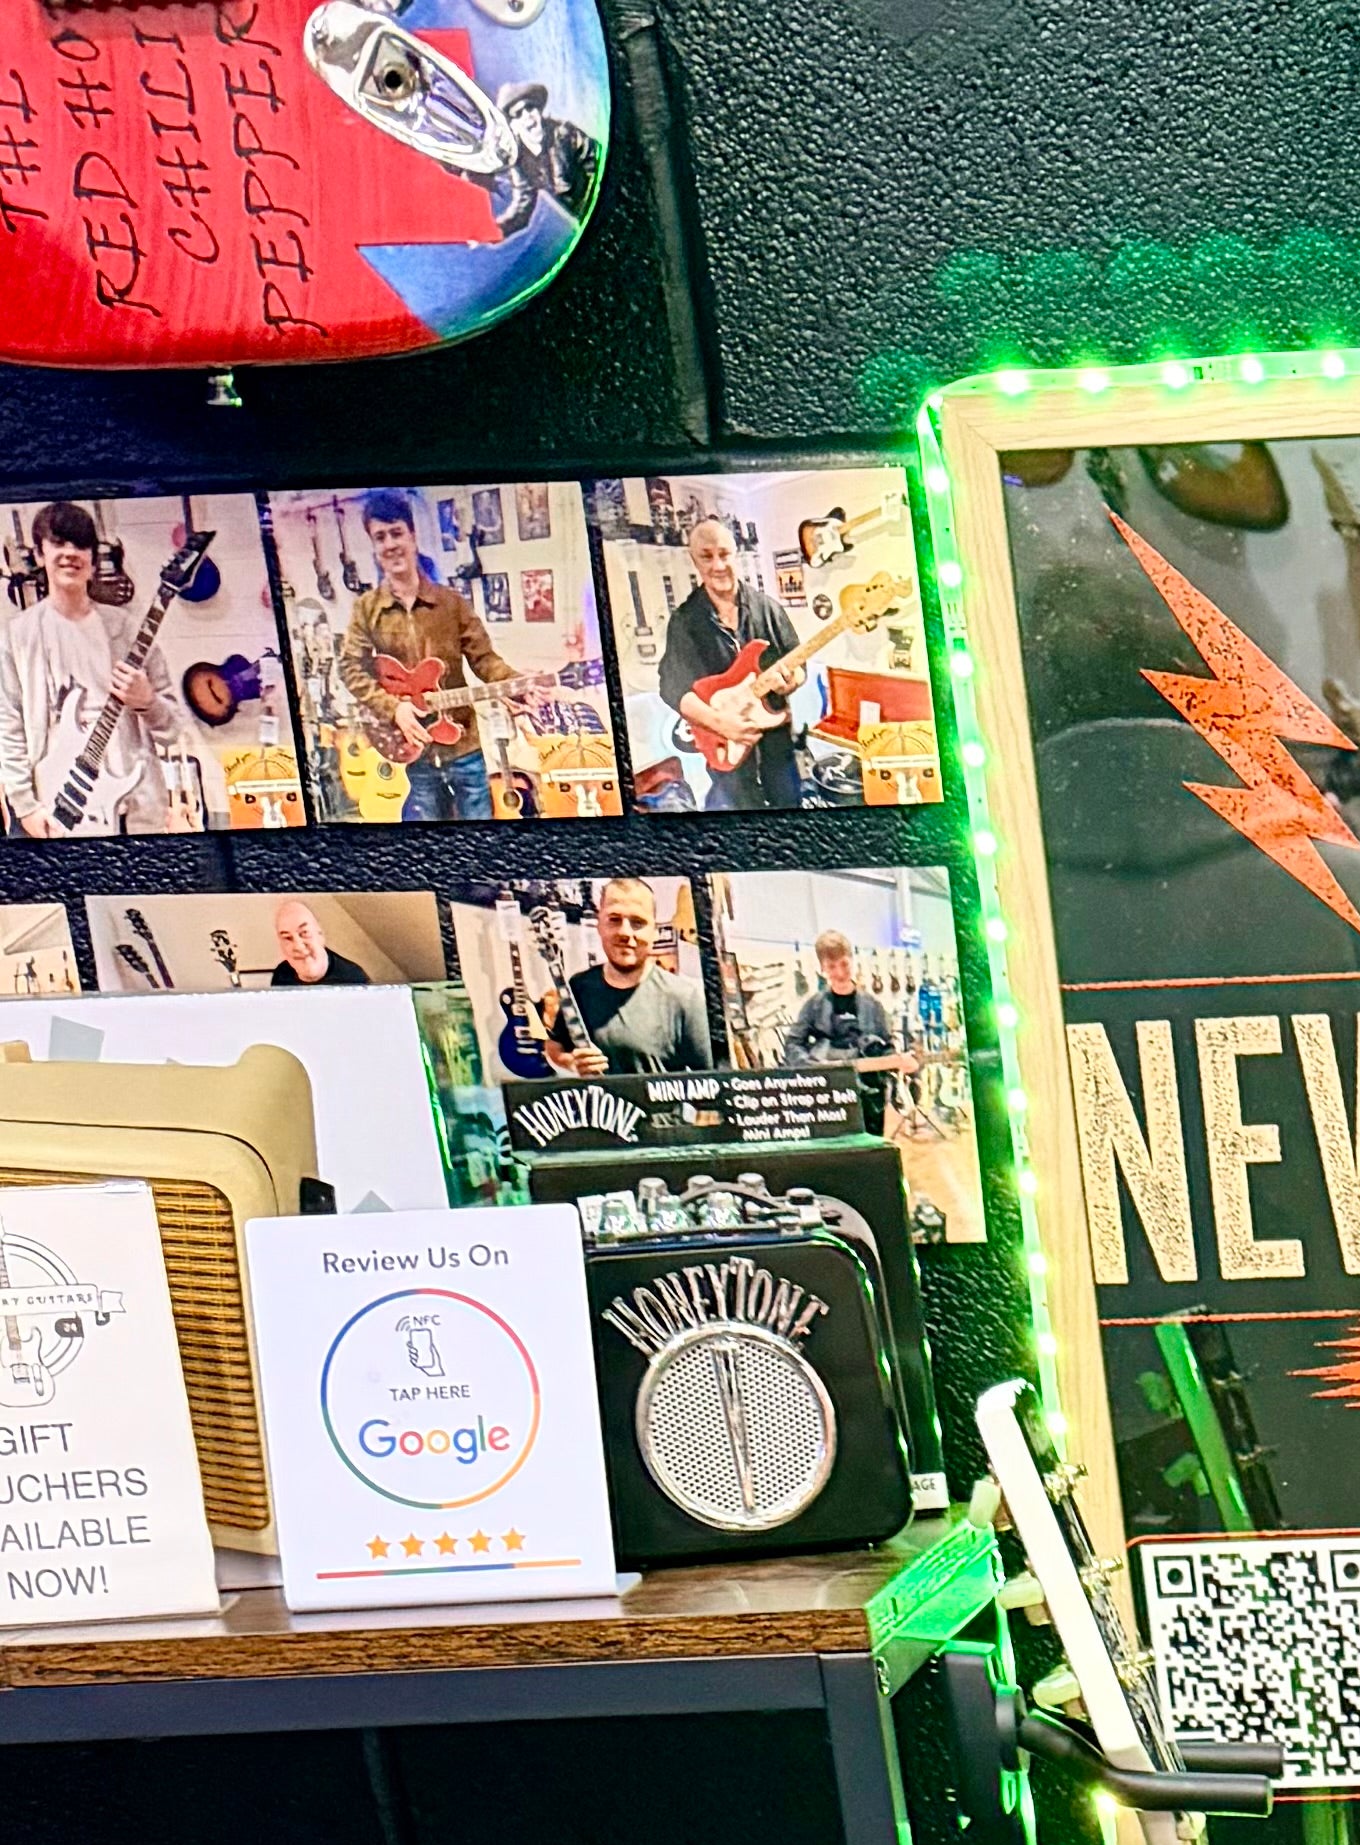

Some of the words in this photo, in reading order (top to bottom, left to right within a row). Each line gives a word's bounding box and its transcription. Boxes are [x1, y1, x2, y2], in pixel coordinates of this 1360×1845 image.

[48, 20, 114, 128] HO
[134, 22, 219, 264] CHILI
[215, 1, 328, 338] PEPPER
[73, 152, 162, 317] RED
[647, 1080, 684, 1101] MINI
[686, 1078, 720, 1100] AMP
[763, 1074, 827, 1091] Anywhere
[512, 1085, 647, 1147] HONEYTONE
[737, 1113, 781, 1127] Louder
[322, 1248, 419, 1275] Review
[427, 1246, 461, 1270] Us
[468, 1244, 510, 1267] On
[413, 1314, 441, 1328] NFC
[389, 1386, 421, 1402] TAP
[425, 1384, 471, 1400] HERE
[358, 1415, 510, 1465] Google
[0, 1467, 148, 1503] UCHERS
[1, 1515, 151, 1551] AILABLE
[7, 1565, 109, 1600] NOW!
